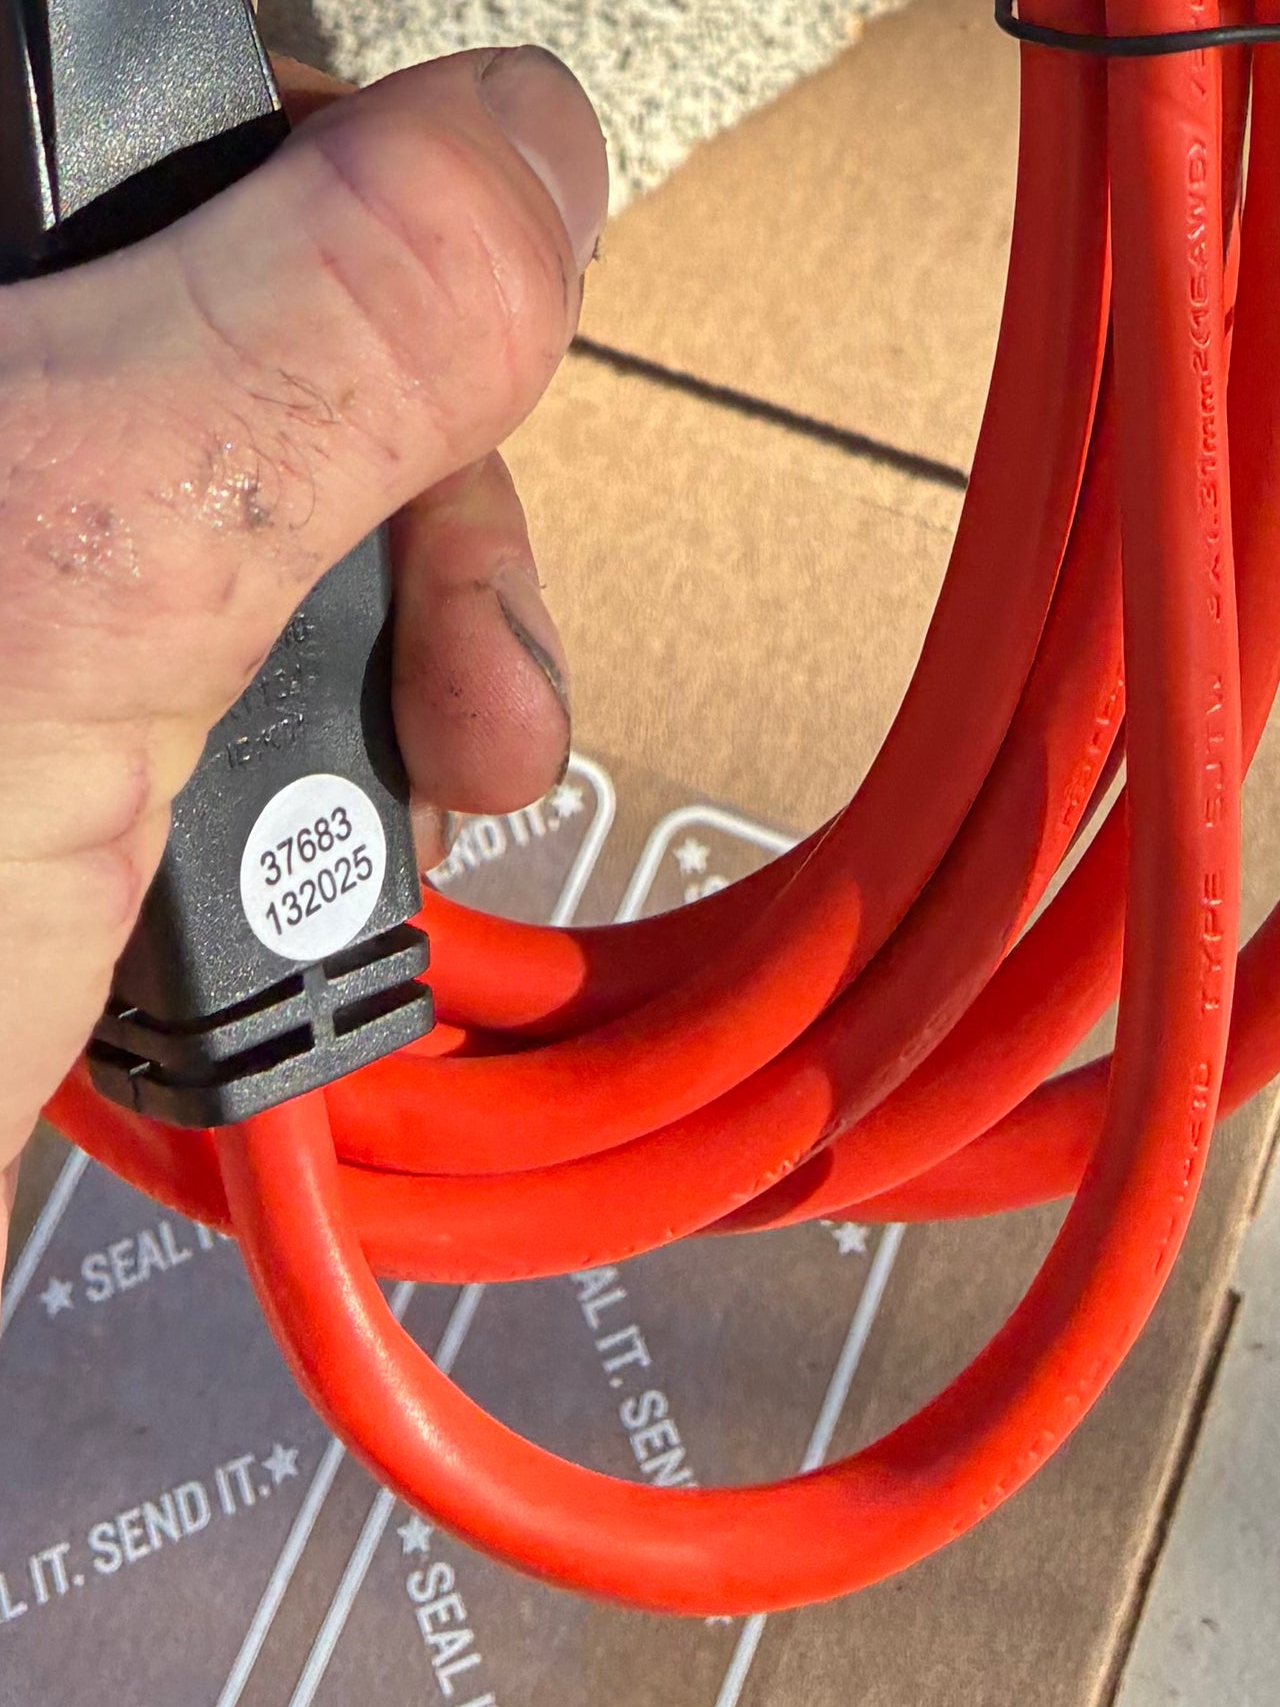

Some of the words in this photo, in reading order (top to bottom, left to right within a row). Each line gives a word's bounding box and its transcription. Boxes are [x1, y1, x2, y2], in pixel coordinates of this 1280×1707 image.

[260, 806, 353, 886] 37683
[265, 843, 375, 936] 132025
[80, 1219, 194, 1303] SEAL
[594, 1323, 653, 1390] IT.
[619, 1389, 701, 1490] SEN
[28, 1540, 86, 1606] IT.
[87, 1479, 212, 1575] SEND
[214, 1452, 271, 1516] IT.
[405, 1560, 483, 1699] SEAL
